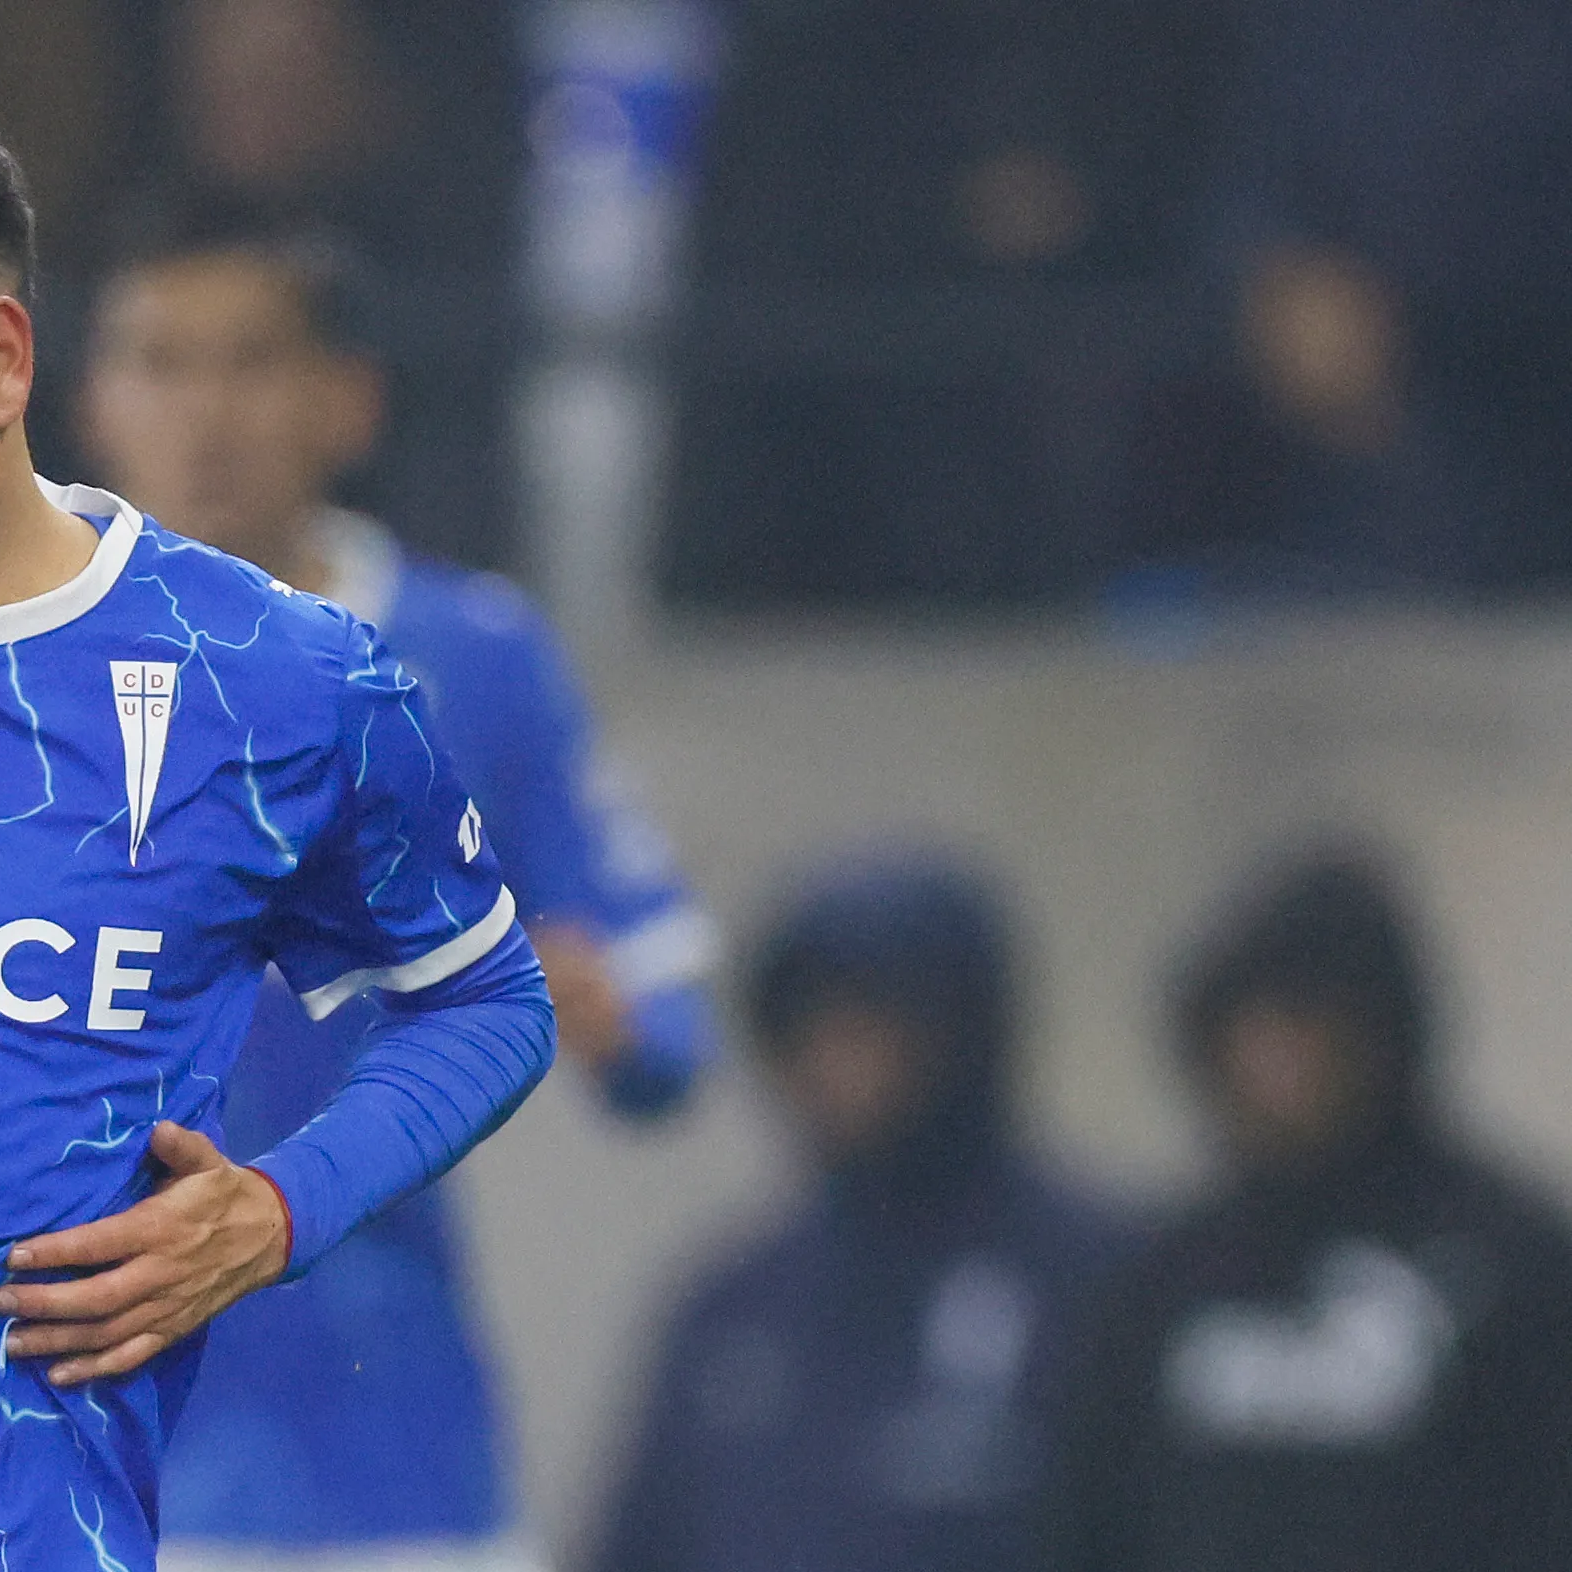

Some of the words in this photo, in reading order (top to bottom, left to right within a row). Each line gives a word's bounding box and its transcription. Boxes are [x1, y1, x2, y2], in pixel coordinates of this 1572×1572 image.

[123, 673, 136, 688] C
[151, 674, 164, 688] D
[124, 702, 136, 716] U
[151, 703, 164, 718] C
